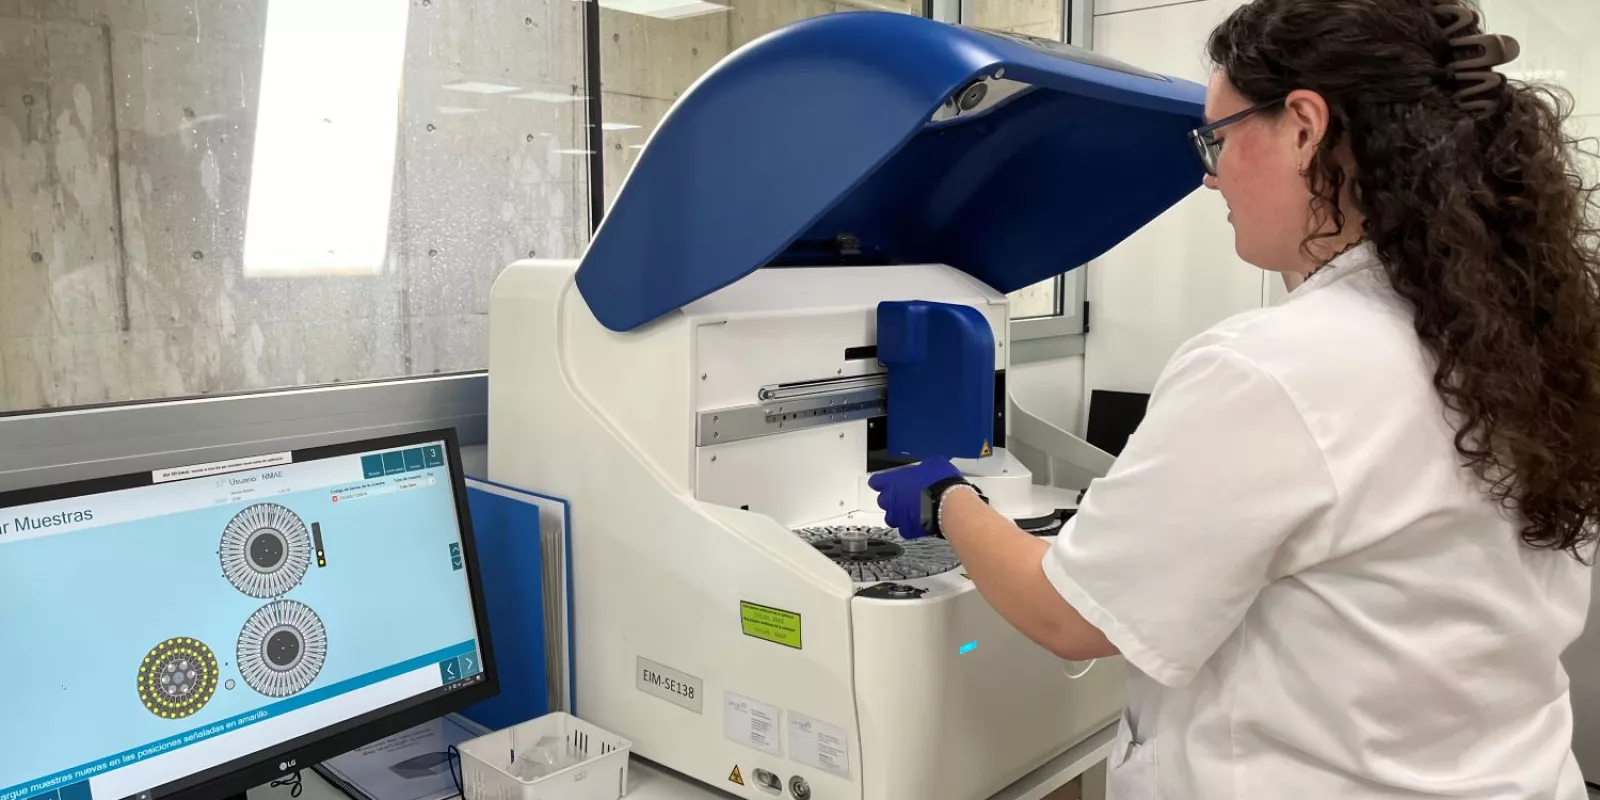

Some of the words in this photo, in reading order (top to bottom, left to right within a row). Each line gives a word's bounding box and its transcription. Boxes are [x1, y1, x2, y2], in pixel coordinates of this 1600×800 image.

[430, 448, 436, 458] 3
[14, 509, 93, 532] Muestras
[643, 669, 694, 700] EIM-SE138
[30, 774, 73, 793] muestras
[75, 762, 108, 778] nuevas
[109, 758, 121, 767] en
[122, 753, 135, 763] las
[137, 738, 182, 760] posiciones
[183, 723, 225, 742] señaladas
[226, 719, 237, 729] en
[287, 759, 296, 767] LG
